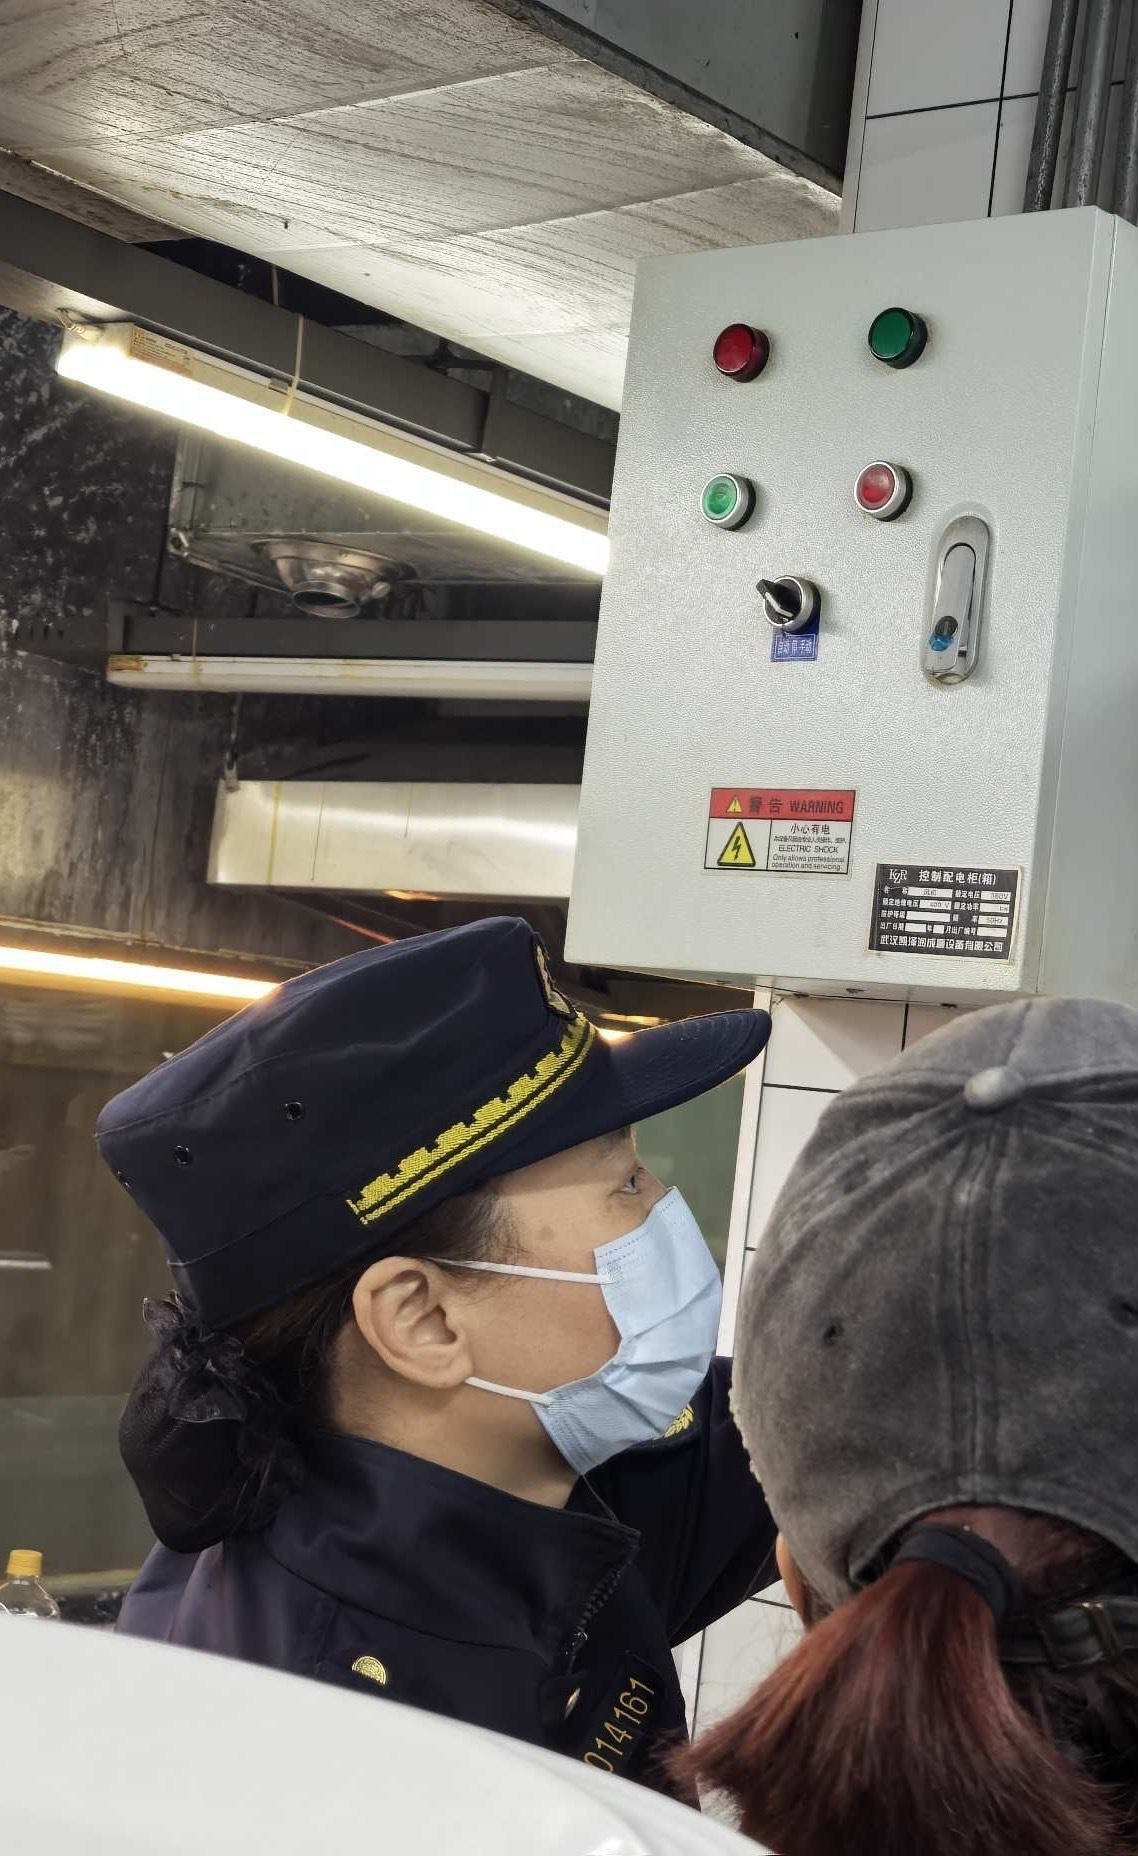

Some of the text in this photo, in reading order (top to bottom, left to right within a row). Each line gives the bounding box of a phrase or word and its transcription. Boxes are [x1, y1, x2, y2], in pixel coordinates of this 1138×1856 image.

[790, 799, 844, 814] WARNING
[790, 823, 830, 835] 小心有电
[778, 844, 839, 853] ELECTRIC SHOCK
[919, 869, 996, 886] 控制配电柜(箱)
[584, 1677, 655, 1773] 014161
